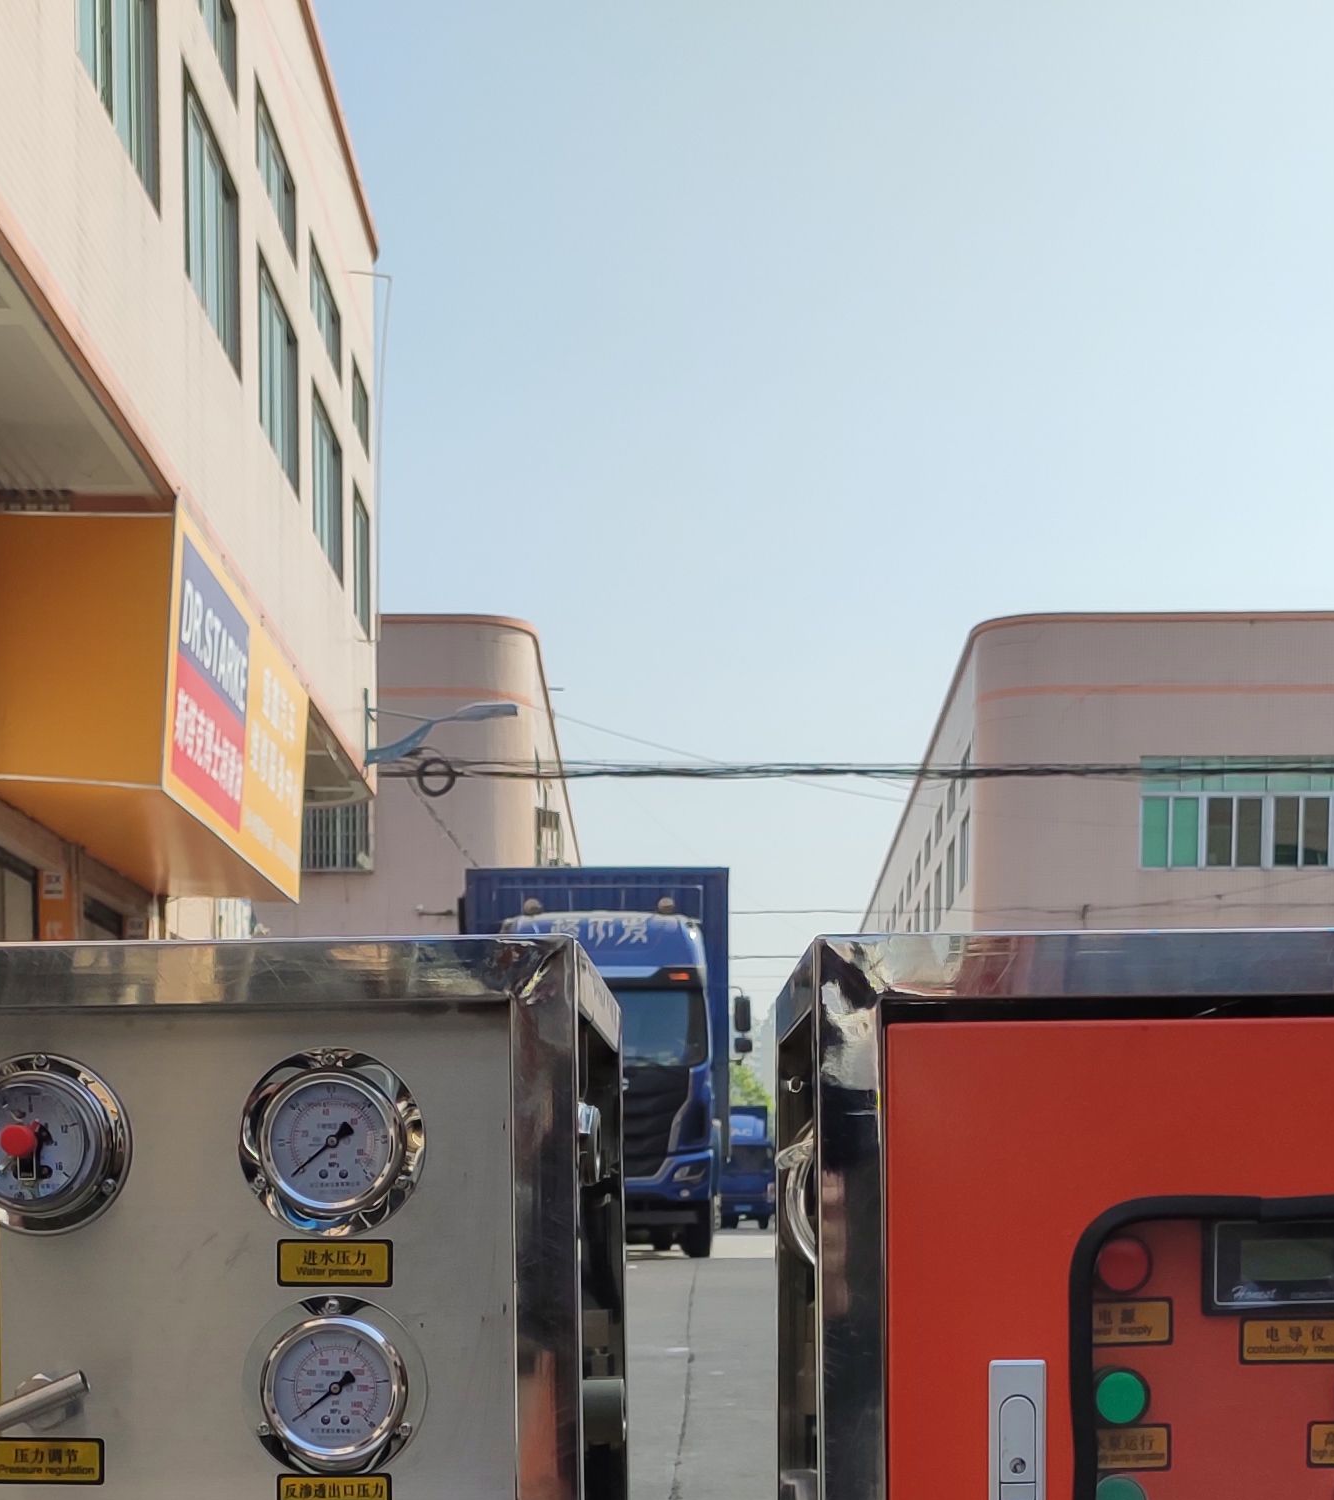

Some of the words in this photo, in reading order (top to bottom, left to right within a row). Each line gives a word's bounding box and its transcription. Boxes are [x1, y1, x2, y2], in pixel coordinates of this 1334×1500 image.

[181, 579, 247, 713] DR.STARKE
[302, 1249, 366, 1266] 进水压力
[296, 1267, 326, 1276] Water
[328, 1268, 372, 1277] pressure
[1231, 1284, 1277, 1300] Honest
[1265, 1326, 1325, 1341] 电导仪
[1247, 1343, 1308, 1356] conductivity
[14, 1448, 78, 1465] 压力调节
[45, 1464, 94, 1476] regulation
[285, 1483, 383, 1499] 反渗透出口压力
